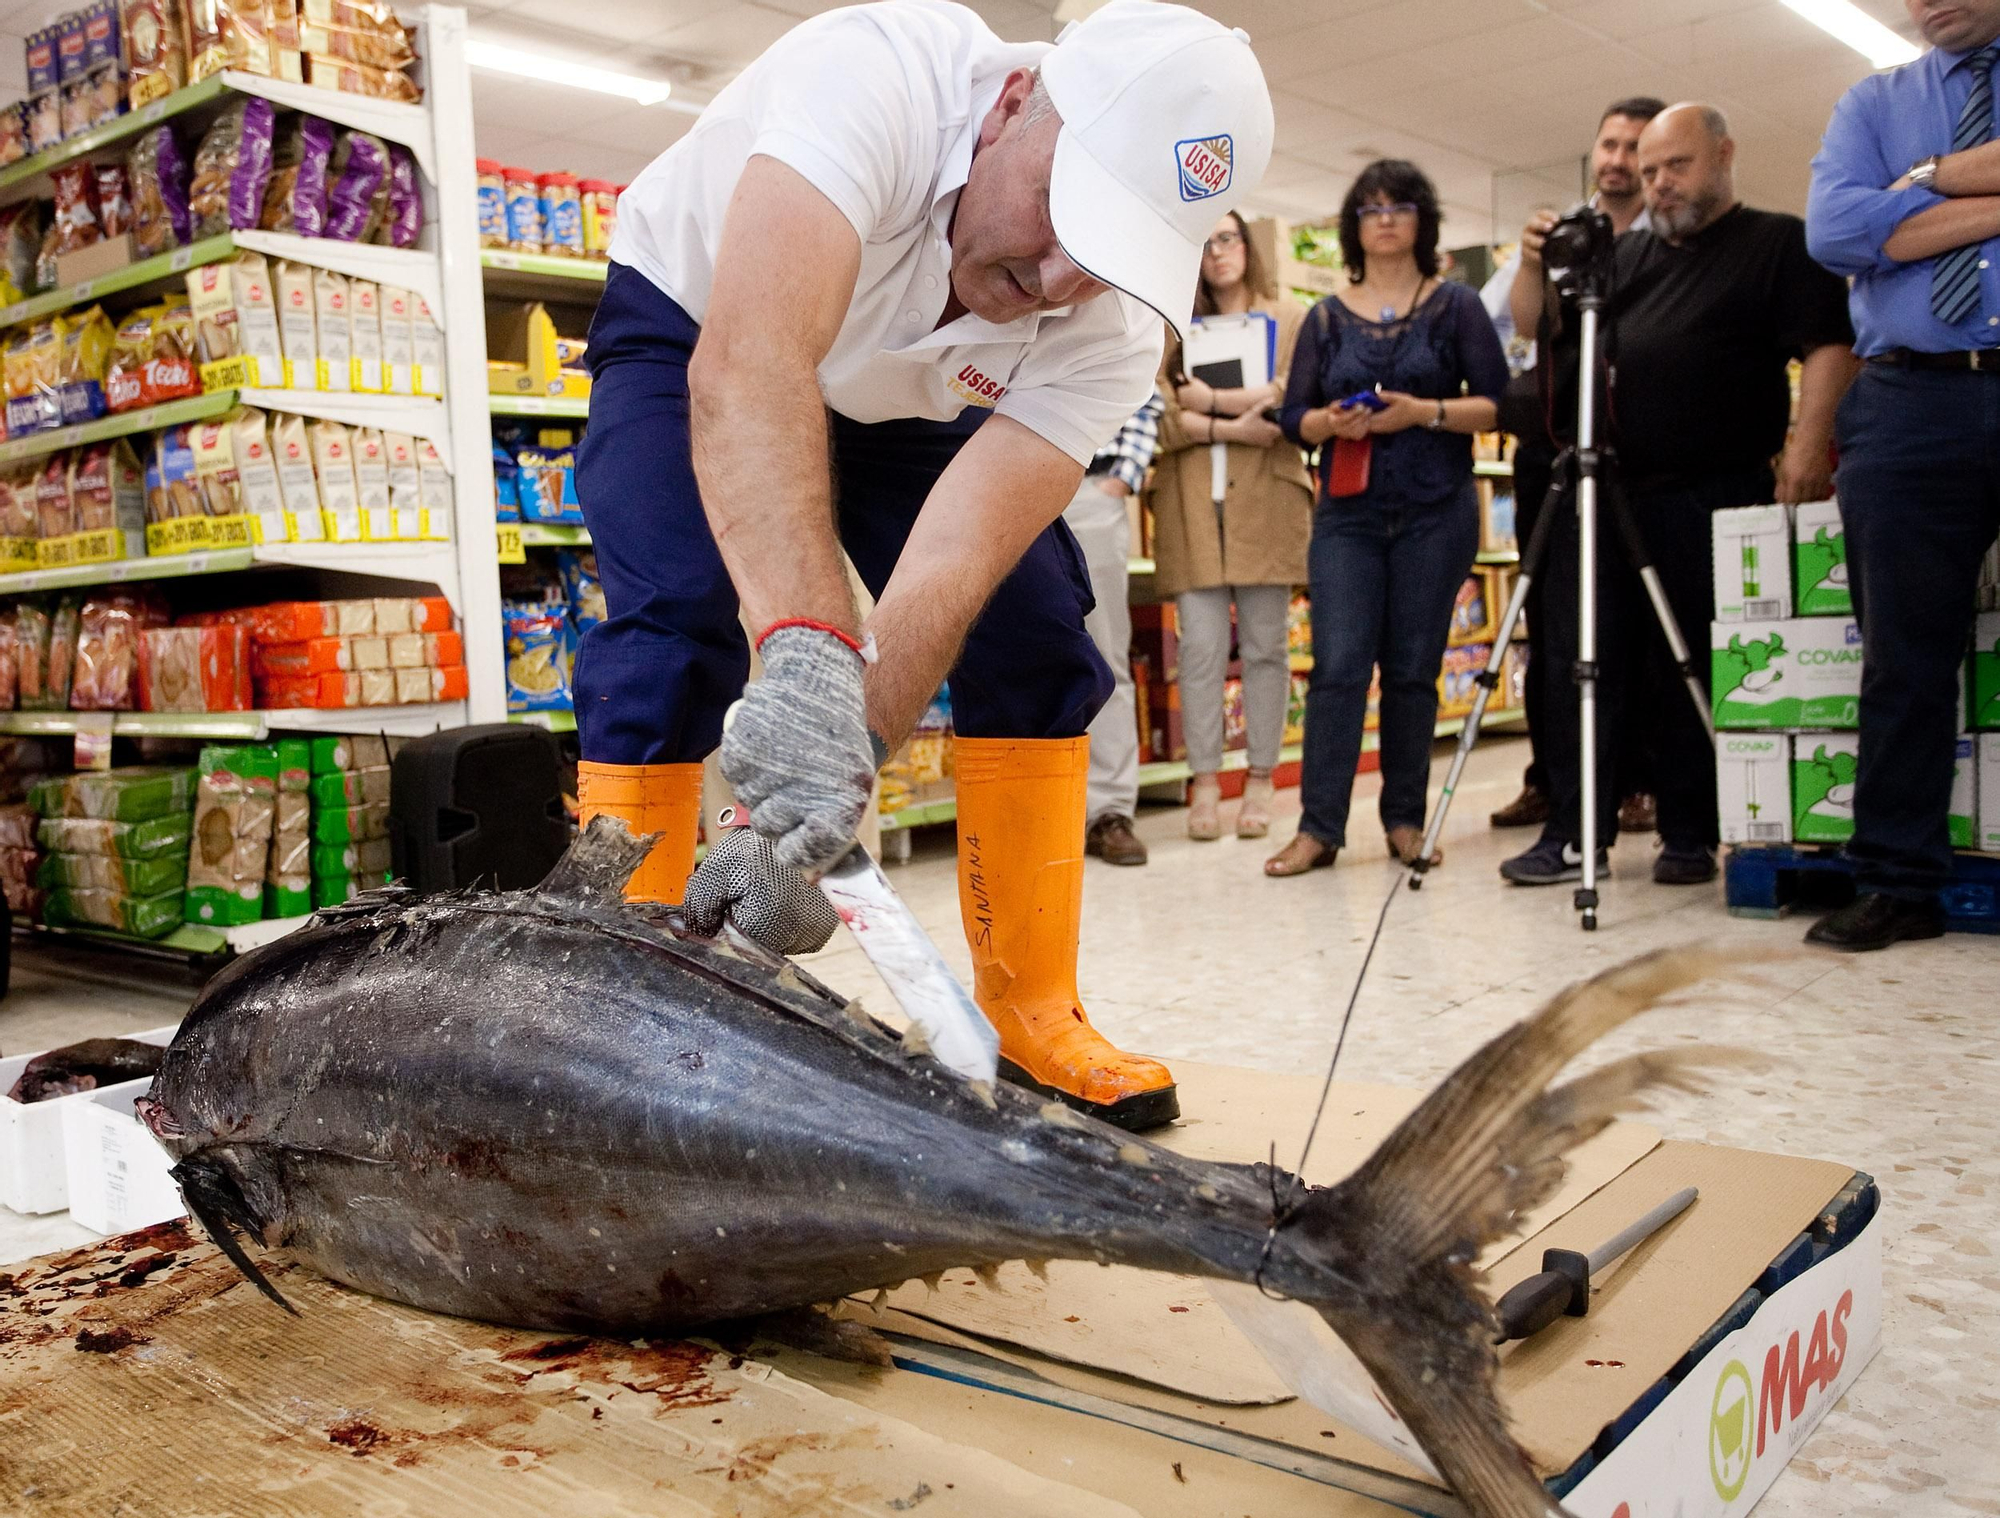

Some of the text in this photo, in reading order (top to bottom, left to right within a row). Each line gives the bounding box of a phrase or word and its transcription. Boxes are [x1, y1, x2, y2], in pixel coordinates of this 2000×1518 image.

[1184, 144, 1228, 192] USISA
[946, 376, 995, 407] TEJERO
[957, 364, 1006, 401] USISA
[1797, 648, 1863, 666] COVAP
[965, 831, 993, 958] SANTANA
[1756, 1288, 1853, 1459] MAS
